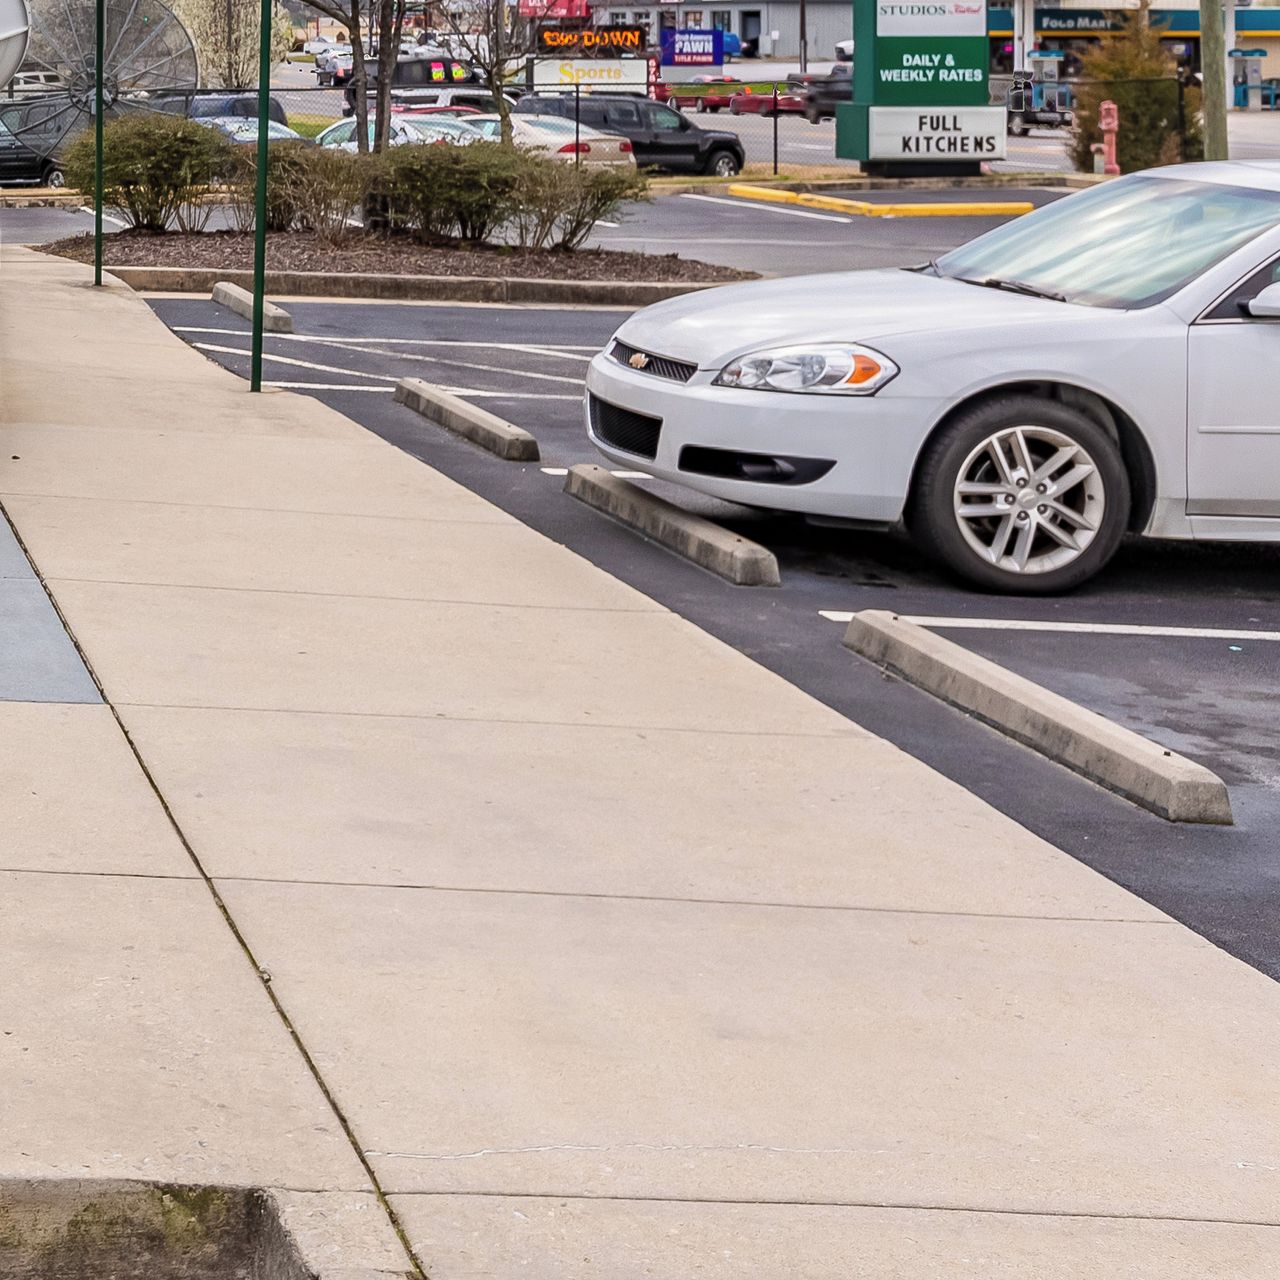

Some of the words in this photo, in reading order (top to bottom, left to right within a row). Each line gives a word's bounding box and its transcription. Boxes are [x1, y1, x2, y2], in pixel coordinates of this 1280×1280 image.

[879, 5, 947, 16] STUDIOS
[582, 31, 640, 47] DOWN
[675, 41, 713, 53] PAWN
[902, 54, 941, 67] DAILY
[944, 53, 956, 67] &
[559, 61, 624, 84] Sports
[880, 69, 936, 82] WEEKLY
[938, 69, 984, 82] RATES
[918, 115, 963, 132] FULL
[901, 136, 997, 153] KITCHENS
